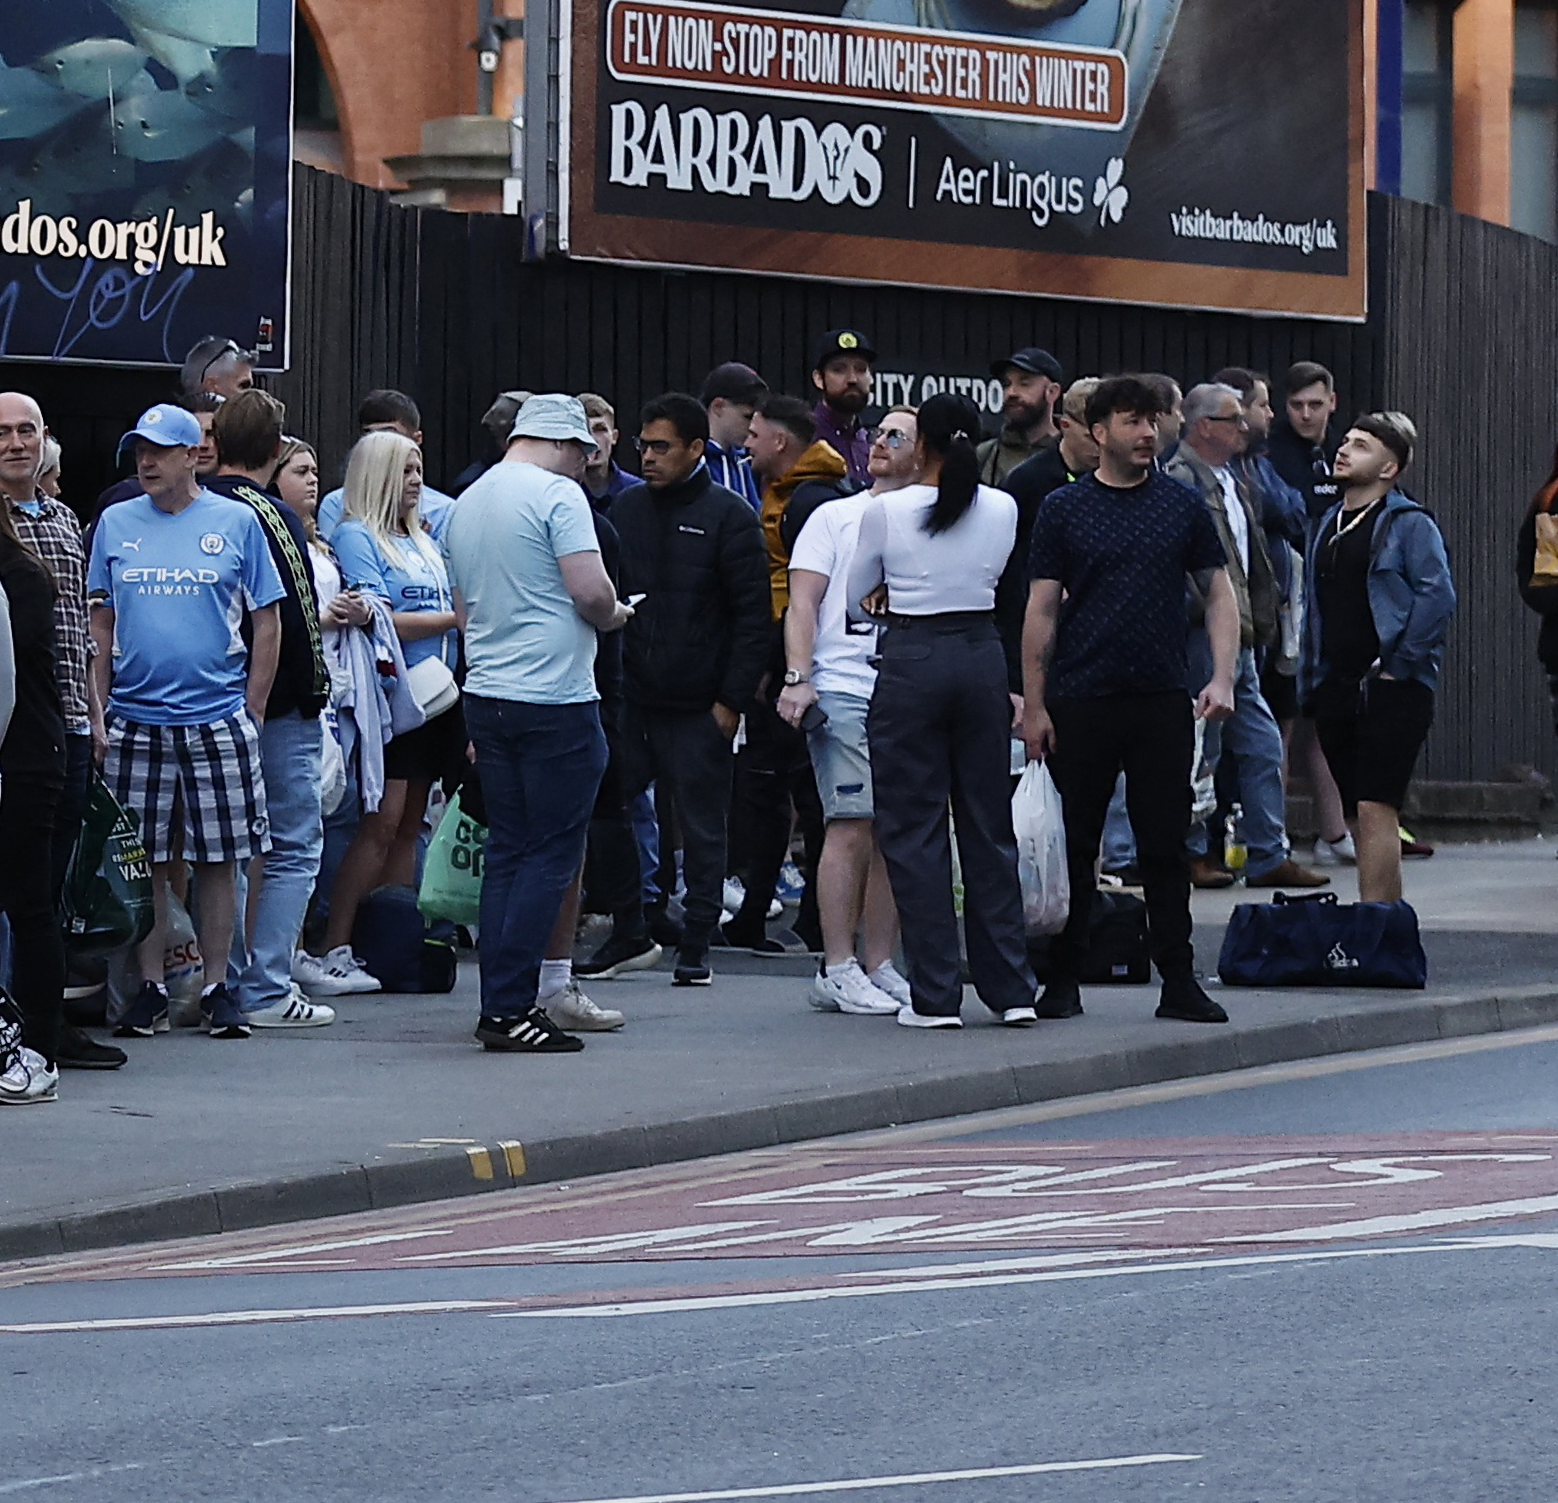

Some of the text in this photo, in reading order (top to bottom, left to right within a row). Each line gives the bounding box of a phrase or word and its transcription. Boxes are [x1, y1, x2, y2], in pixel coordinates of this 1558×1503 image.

[623, 10, 1110, 115] FLY NON-STOP FROM MANCHESTER THIS WINTER
[935, 155, 1084, 228] Aer Lingus
[1170, 205, 1337, 255] visitbarbados.org/uk
[122, 568, 219, 584] ETIHAD
[138, 585, 200, 596] AIRWAYS
[695, 1154, 1553, 1207] BUS
[143, 1203, 1356, 1270] LANE
